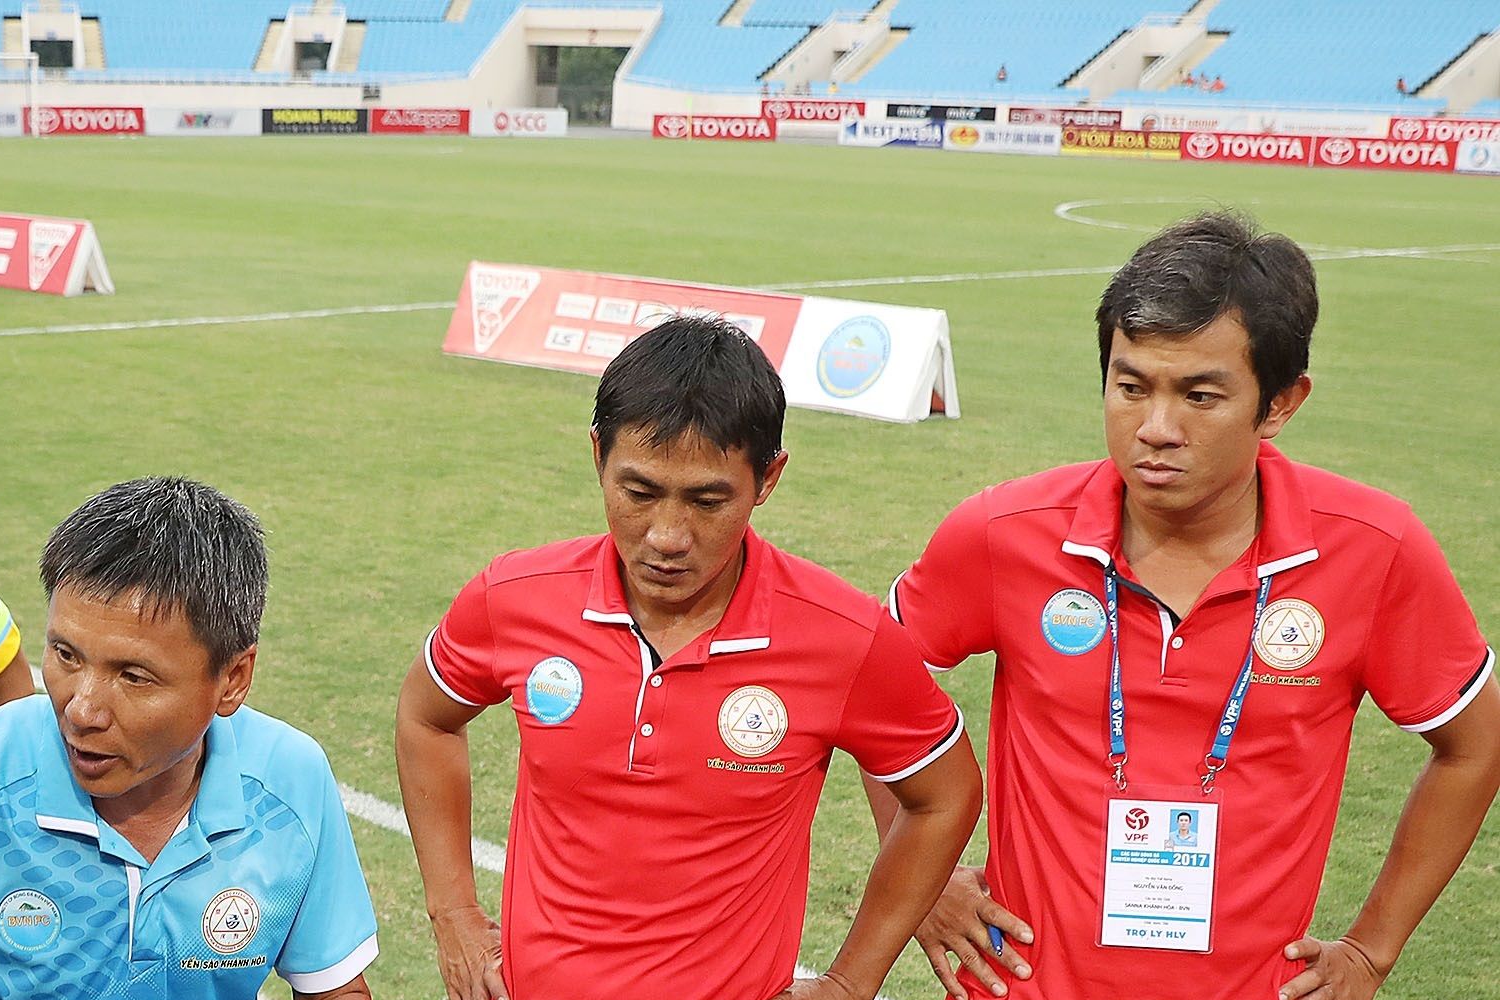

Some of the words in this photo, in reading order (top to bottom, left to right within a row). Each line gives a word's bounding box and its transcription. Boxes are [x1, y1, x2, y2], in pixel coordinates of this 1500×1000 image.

[61, 110, 141, 131] TOYOTA
[402, 110, 461, 129] Kappa
[791, 101, 864, 121] TOYOTA
[513, 113, 548, 132] SCG
[691, 117, 771, 138] TOYOTA
[1426, 120, 1500, 143] TOYOTA
[1220, 136, 1304, 160] TOYOTA
[1356, 140, 1449, 167] TOYOTA
[1052, 614, 1077, 627] BVN
[1223, 699, 1240, 724] VPF
[1111, 710, 1123, 737] VPF
[1124, 833, 1149, 842] VPF
[1172, 852, 1208, 867] 2017
[1165, 931, 1187, 939] HLV
[180, 956, 200, 969] YẾN
[202, 959, 219, 970] SÀO
[220, 957, 250, 968] KHÁNH
